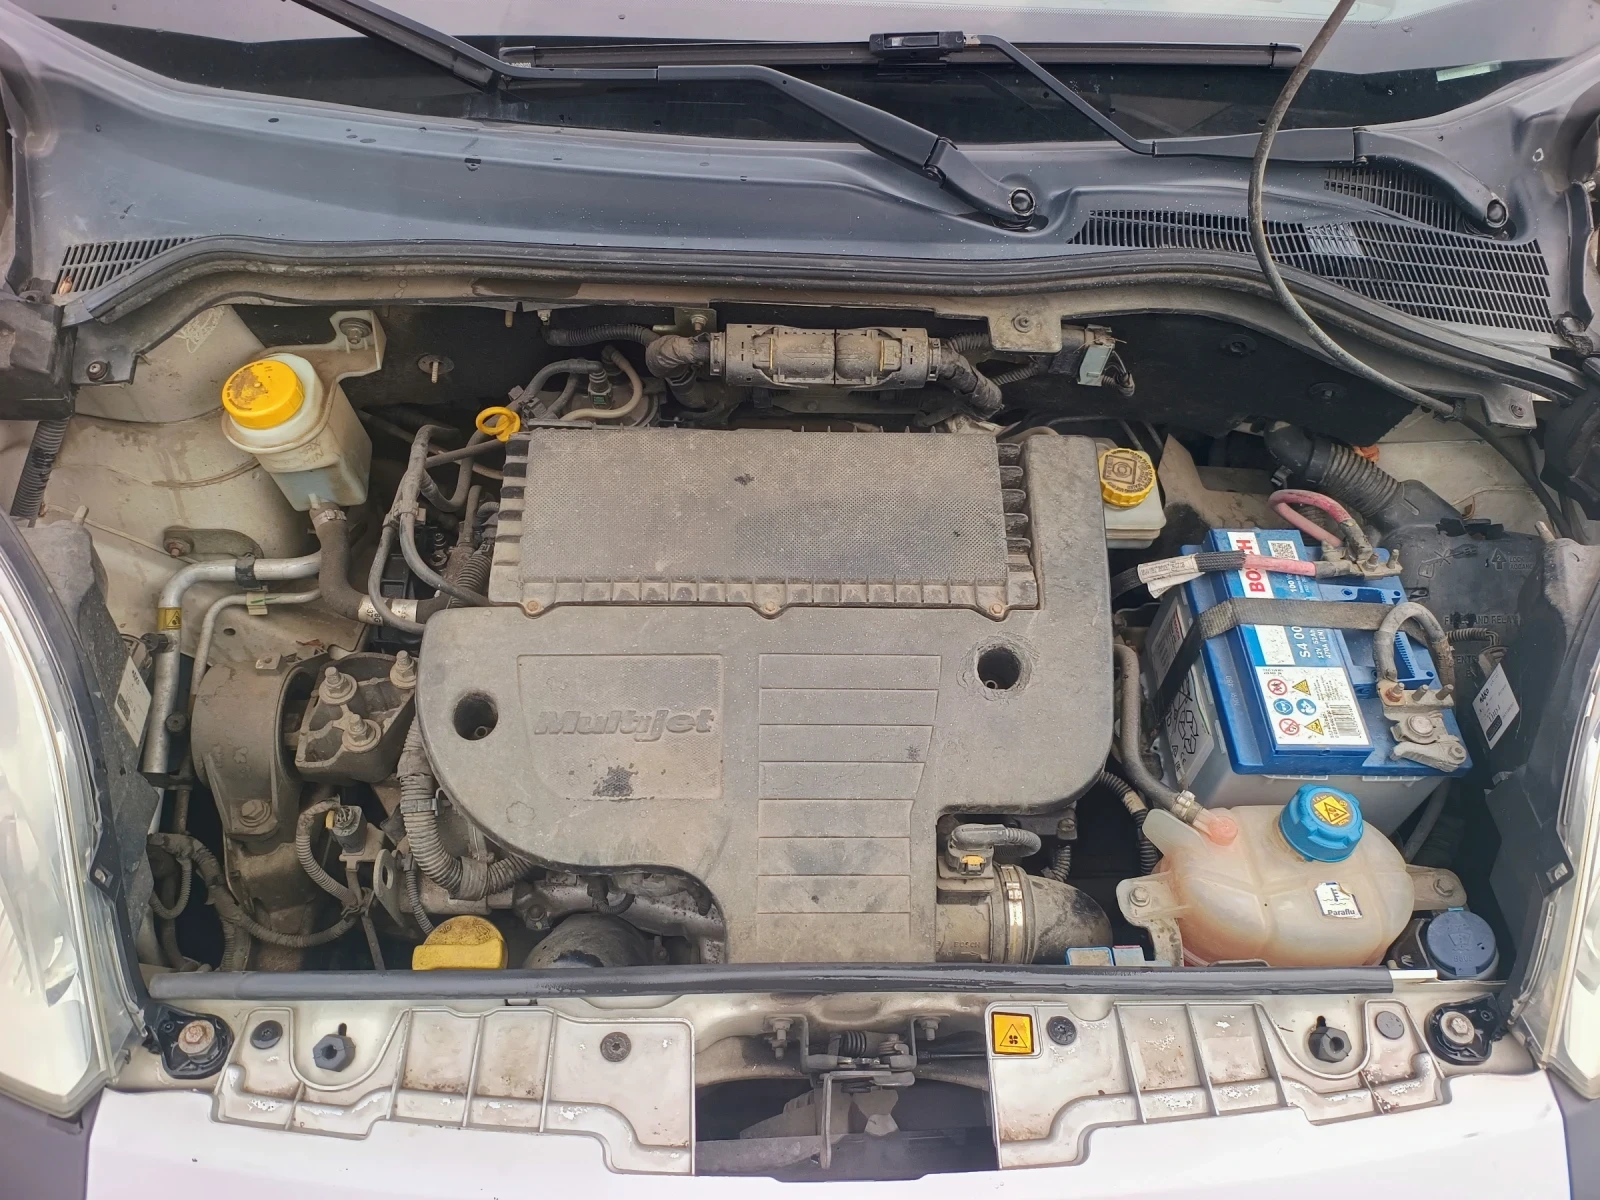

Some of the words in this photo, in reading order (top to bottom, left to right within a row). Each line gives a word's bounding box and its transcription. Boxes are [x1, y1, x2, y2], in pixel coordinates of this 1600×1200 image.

[1236, 540, 1266, 592] BOH
[1288, 580, 1297, 592] 100
[1296, 643, 1311, 658] S4
[1315, 647, 1324, 659] 12V
[1321, 643, 1331, 659] 470A
[534, 709, 714, 742] Multijet
[1327, 908, 1356, 916] Paraflu
